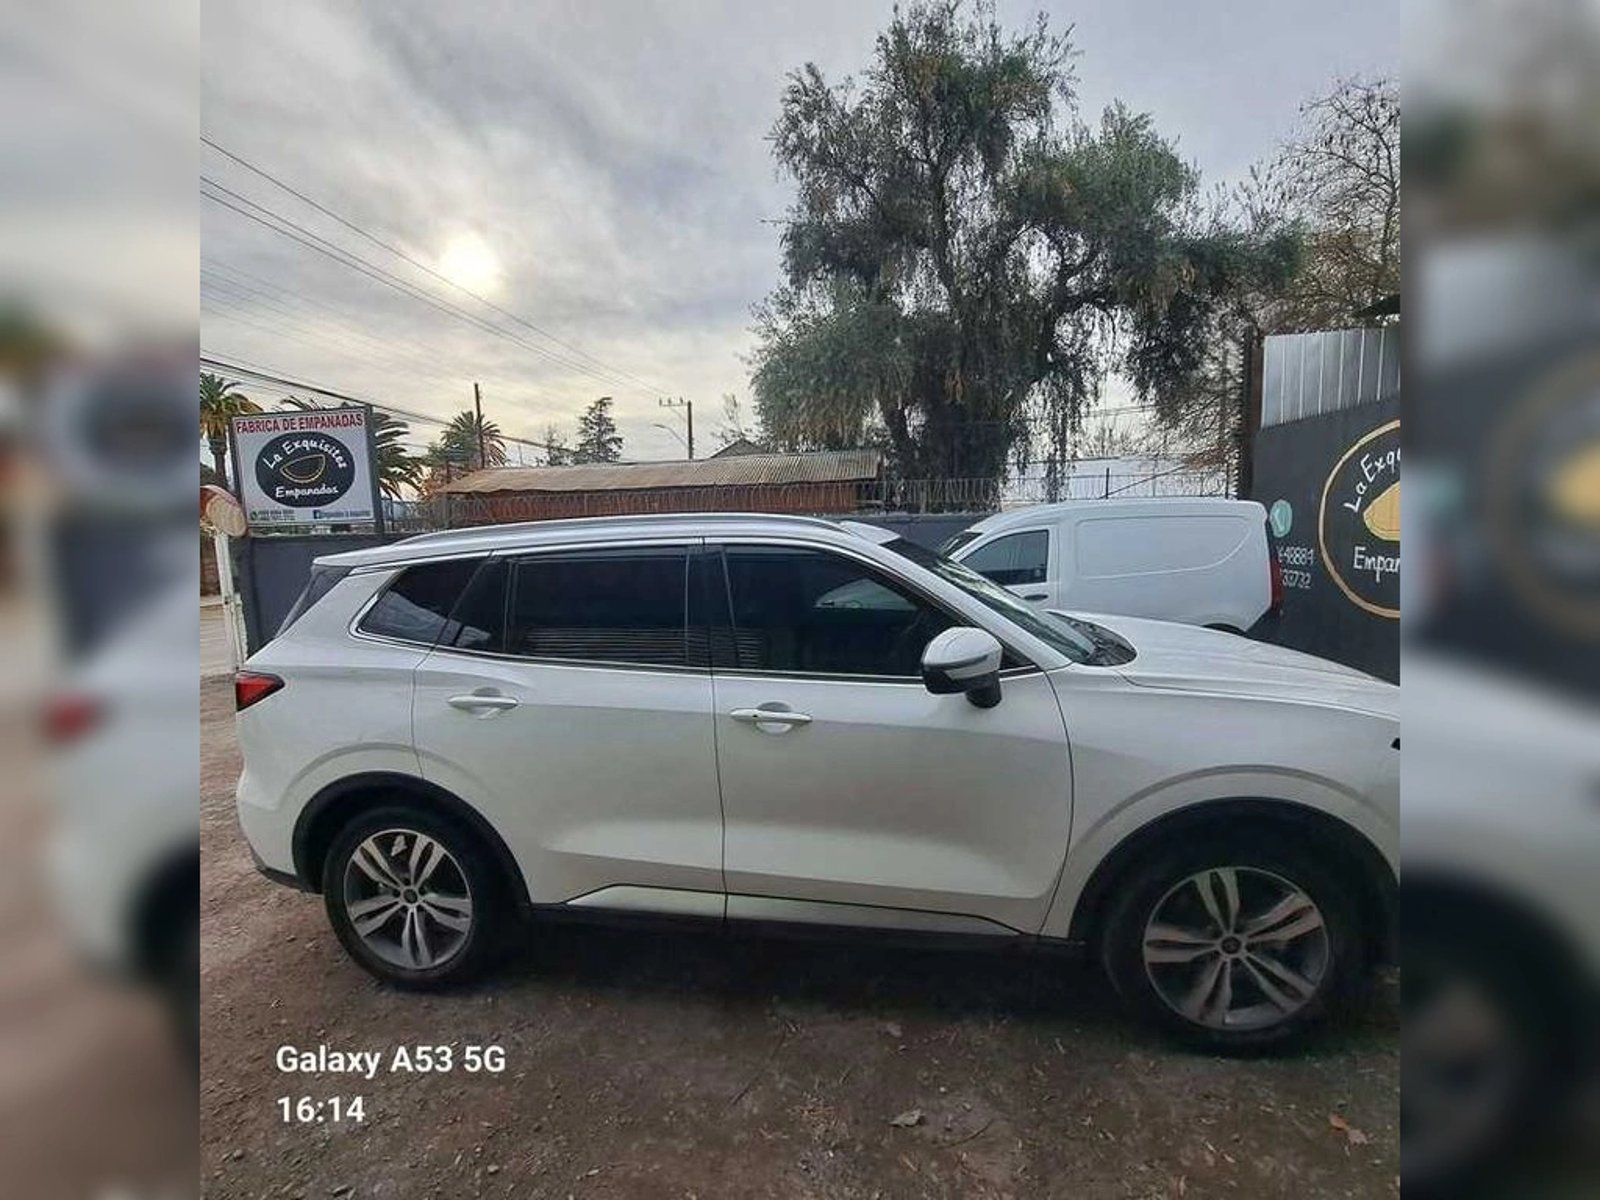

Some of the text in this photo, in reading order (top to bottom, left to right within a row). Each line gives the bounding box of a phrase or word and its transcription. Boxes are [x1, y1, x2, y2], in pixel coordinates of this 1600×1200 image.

[236, 413, 363, 434] FABRICA DE EMPANADAS
[262, 452, 283, 469] La
[275, 483, 339, 499] Empanadas
[1344, 480, 1368, 513] La
